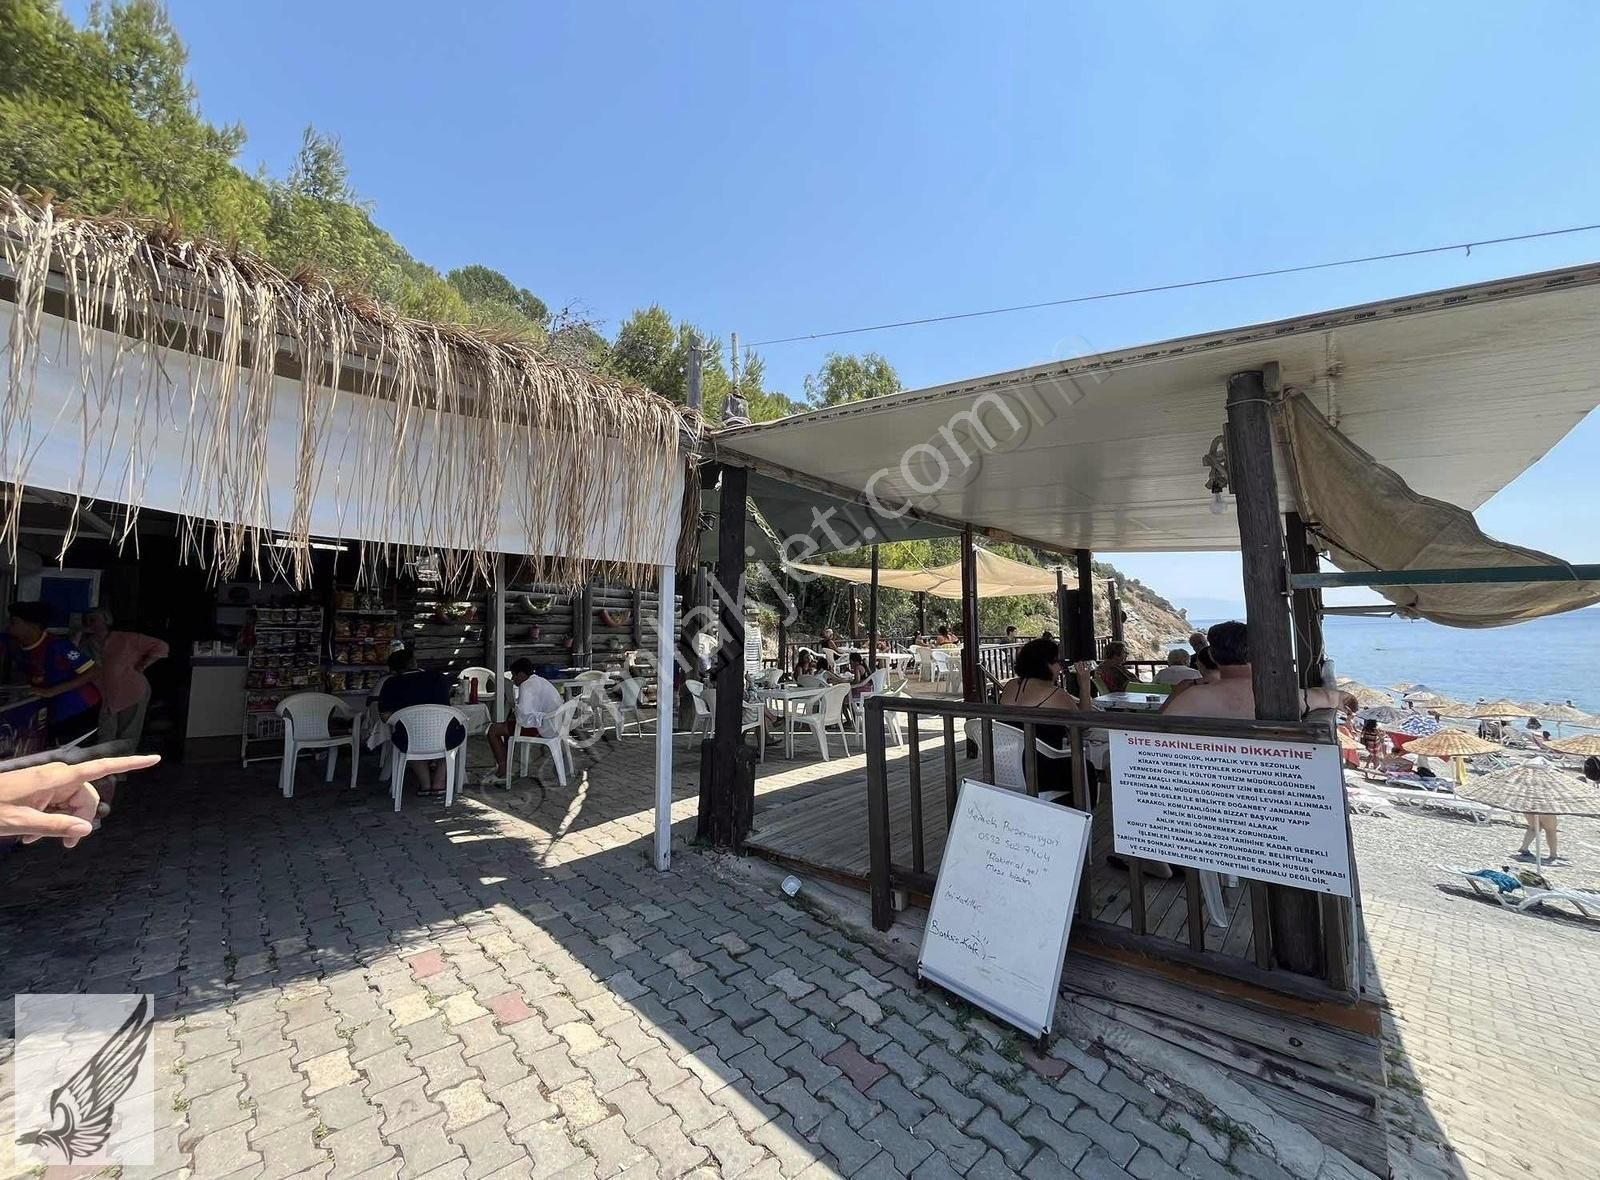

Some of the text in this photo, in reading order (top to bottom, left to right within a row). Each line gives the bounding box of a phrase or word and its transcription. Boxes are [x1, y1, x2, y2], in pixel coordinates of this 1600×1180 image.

[1127, 737, 1313, 760] SİTE SAKİNLERİNİN DİKKATİNE
[1138, 751, 1172, 759] KONUTUNU
[1174, 753, 1203, 761] GÜNLÜK,
[1259, 761, 1300, 770] SEZONLUK
[1128, 766, 1162, 774] VERMEDEN
[1189, 771, 1216, 780] KÜLTÜR
[1218, 774, 1245, 782] TURİZM
[1246, 777, 1315, 790] MÜDÜRLÜĞÜNDEN
[1188, 763, 1230, 772] İSTEYENLER
[1231, 767, 1272, 776] KONUTUNU
[1274, 771, 1302, 779] KİRAYA
[1172, 778, 1209, 787] KİRALANAN
[1253, 787, 1285, 796] BELGESİ
[1287, 791, 1325, 800] ALINMASI
[1173, 786, 1234, 798] MÜDÜRLÜĞÜNDEN
[1235, 793, 1258, 801] VERGİ
[1259, 796, 1291, 805] LEVHASI
[1294, 800, 1332, 810] ALINMASI
[1136, 798, 1310, 826] KARAKOL KOMUTANLIĞINA BİZZAT BAŞVURU YAPIP
[1149, 792, 1181, 800] BELGELER
[1194, 797, 1226, 806] BİRLİKTE
[1227, 801, 1267, 811] DOĞANBEY
[1268, 807, 1311, 817] JANDARMA
[1162, 809, 1185, 818] KİMLİK
[1218, 817, 1246, 826] SİSTEMİ
[1248, 822, 1278, 831] ALARAK
[1176, 819, 1191, 827] VERİ
[1192, 822, 1236, 834] GÖNDERMEK
[1237, 829, 1288, 842] ZORUNDADIR.
[1126, 820, 1147, 828] KONUT
[1148, 823, 1192, 835] SAHİPLERİNİN
[1231, 836, 1264, 847] TARİHİNE
[1266, 842, 1291, 851] KADAR
[1293, 846, 1328, 857] GEREKLİ
[1138, 830, 1313, 864] İŞLEMLERİ TAMAMLAMAK ZORUNDADIR. BELİRTİLEN
[1157, 848, 1197, 861] İŞLEMLERDE
[1198, 856, 1213, 864] SİTE
[1215, 859, 1249, 870] YÖNETİMİ
[1251, 866, 1287, 877] SORUMLU
[1288, 872, 1328, 885] DEĞİLDİR.
[1176, 844, 1203, 854] YAPILAN
[1257, 858, 1280, 867] EKSİK
[1282, 862, 1309, 872] HUSUS
[1311, 867, 1346, 879] ÇIKMASI
